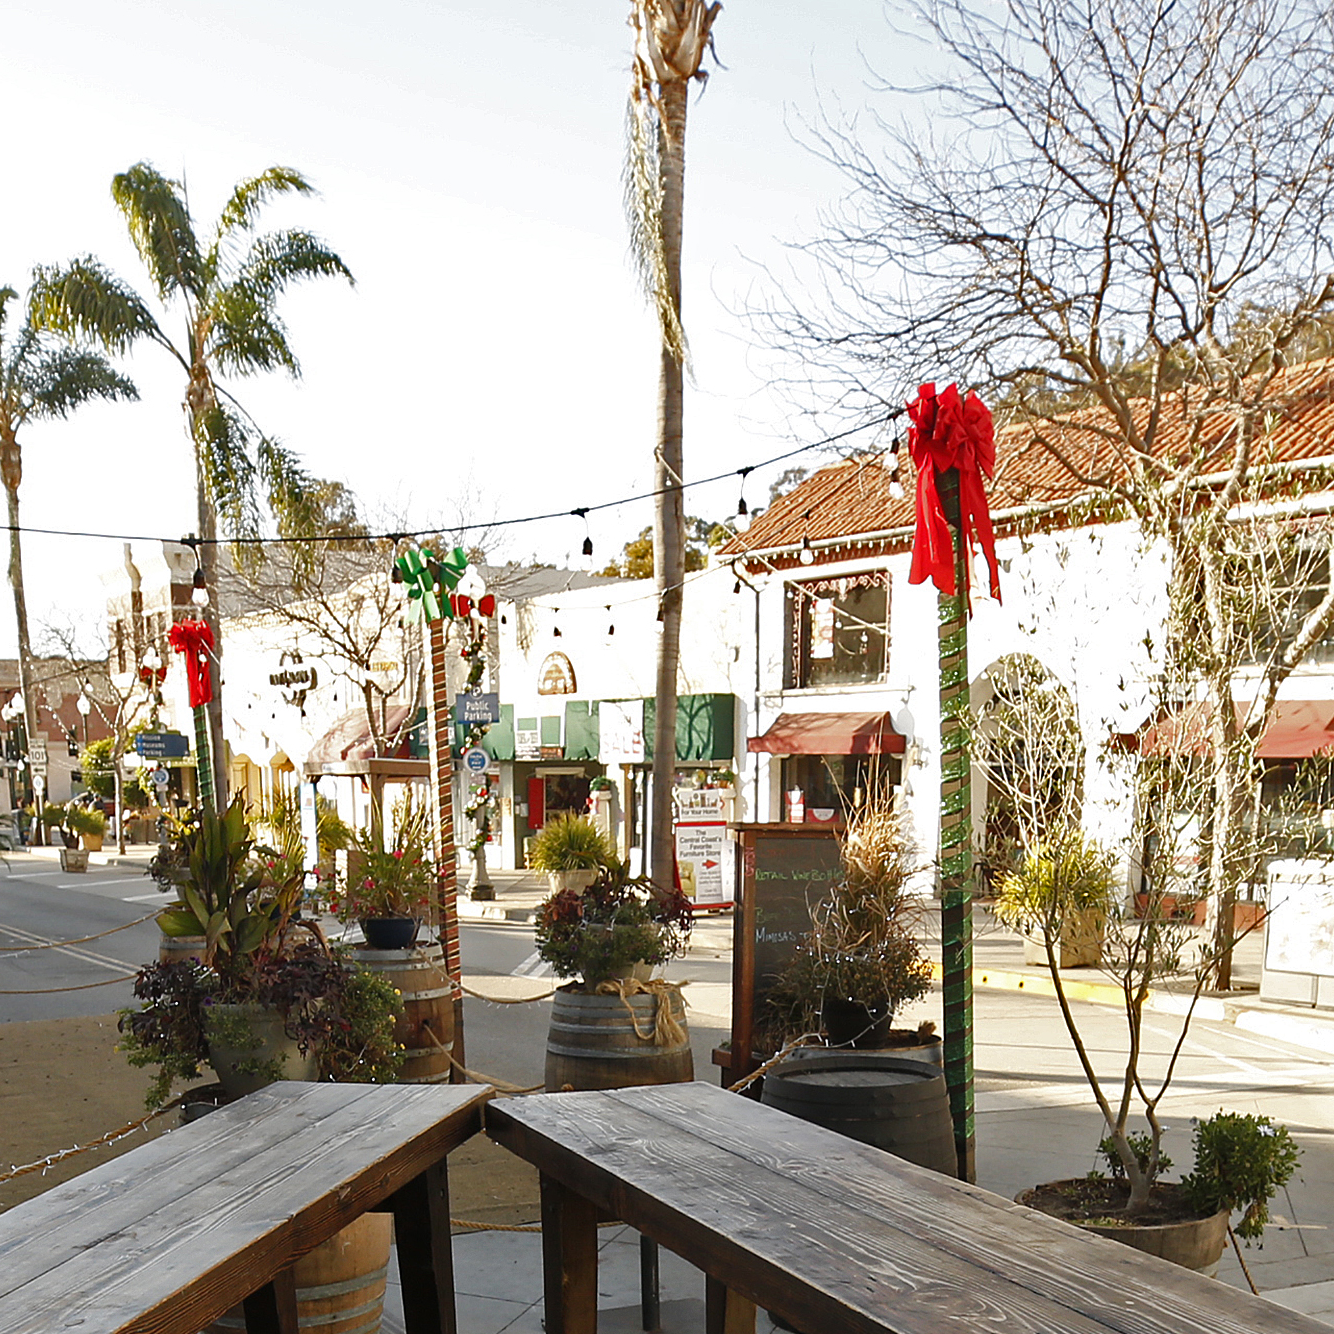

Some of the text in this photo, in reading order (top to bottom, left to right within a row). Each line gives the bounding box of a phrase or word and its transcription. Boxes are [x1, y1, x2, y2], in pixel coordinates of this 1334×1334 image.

[465, 700, 489, 711] Public
[464, 711, 492, 722] Parking
[30, 751, 45, 760] 101
[679, 836, 700, 844] Central
[679, 850, 705, 858] Furniture
